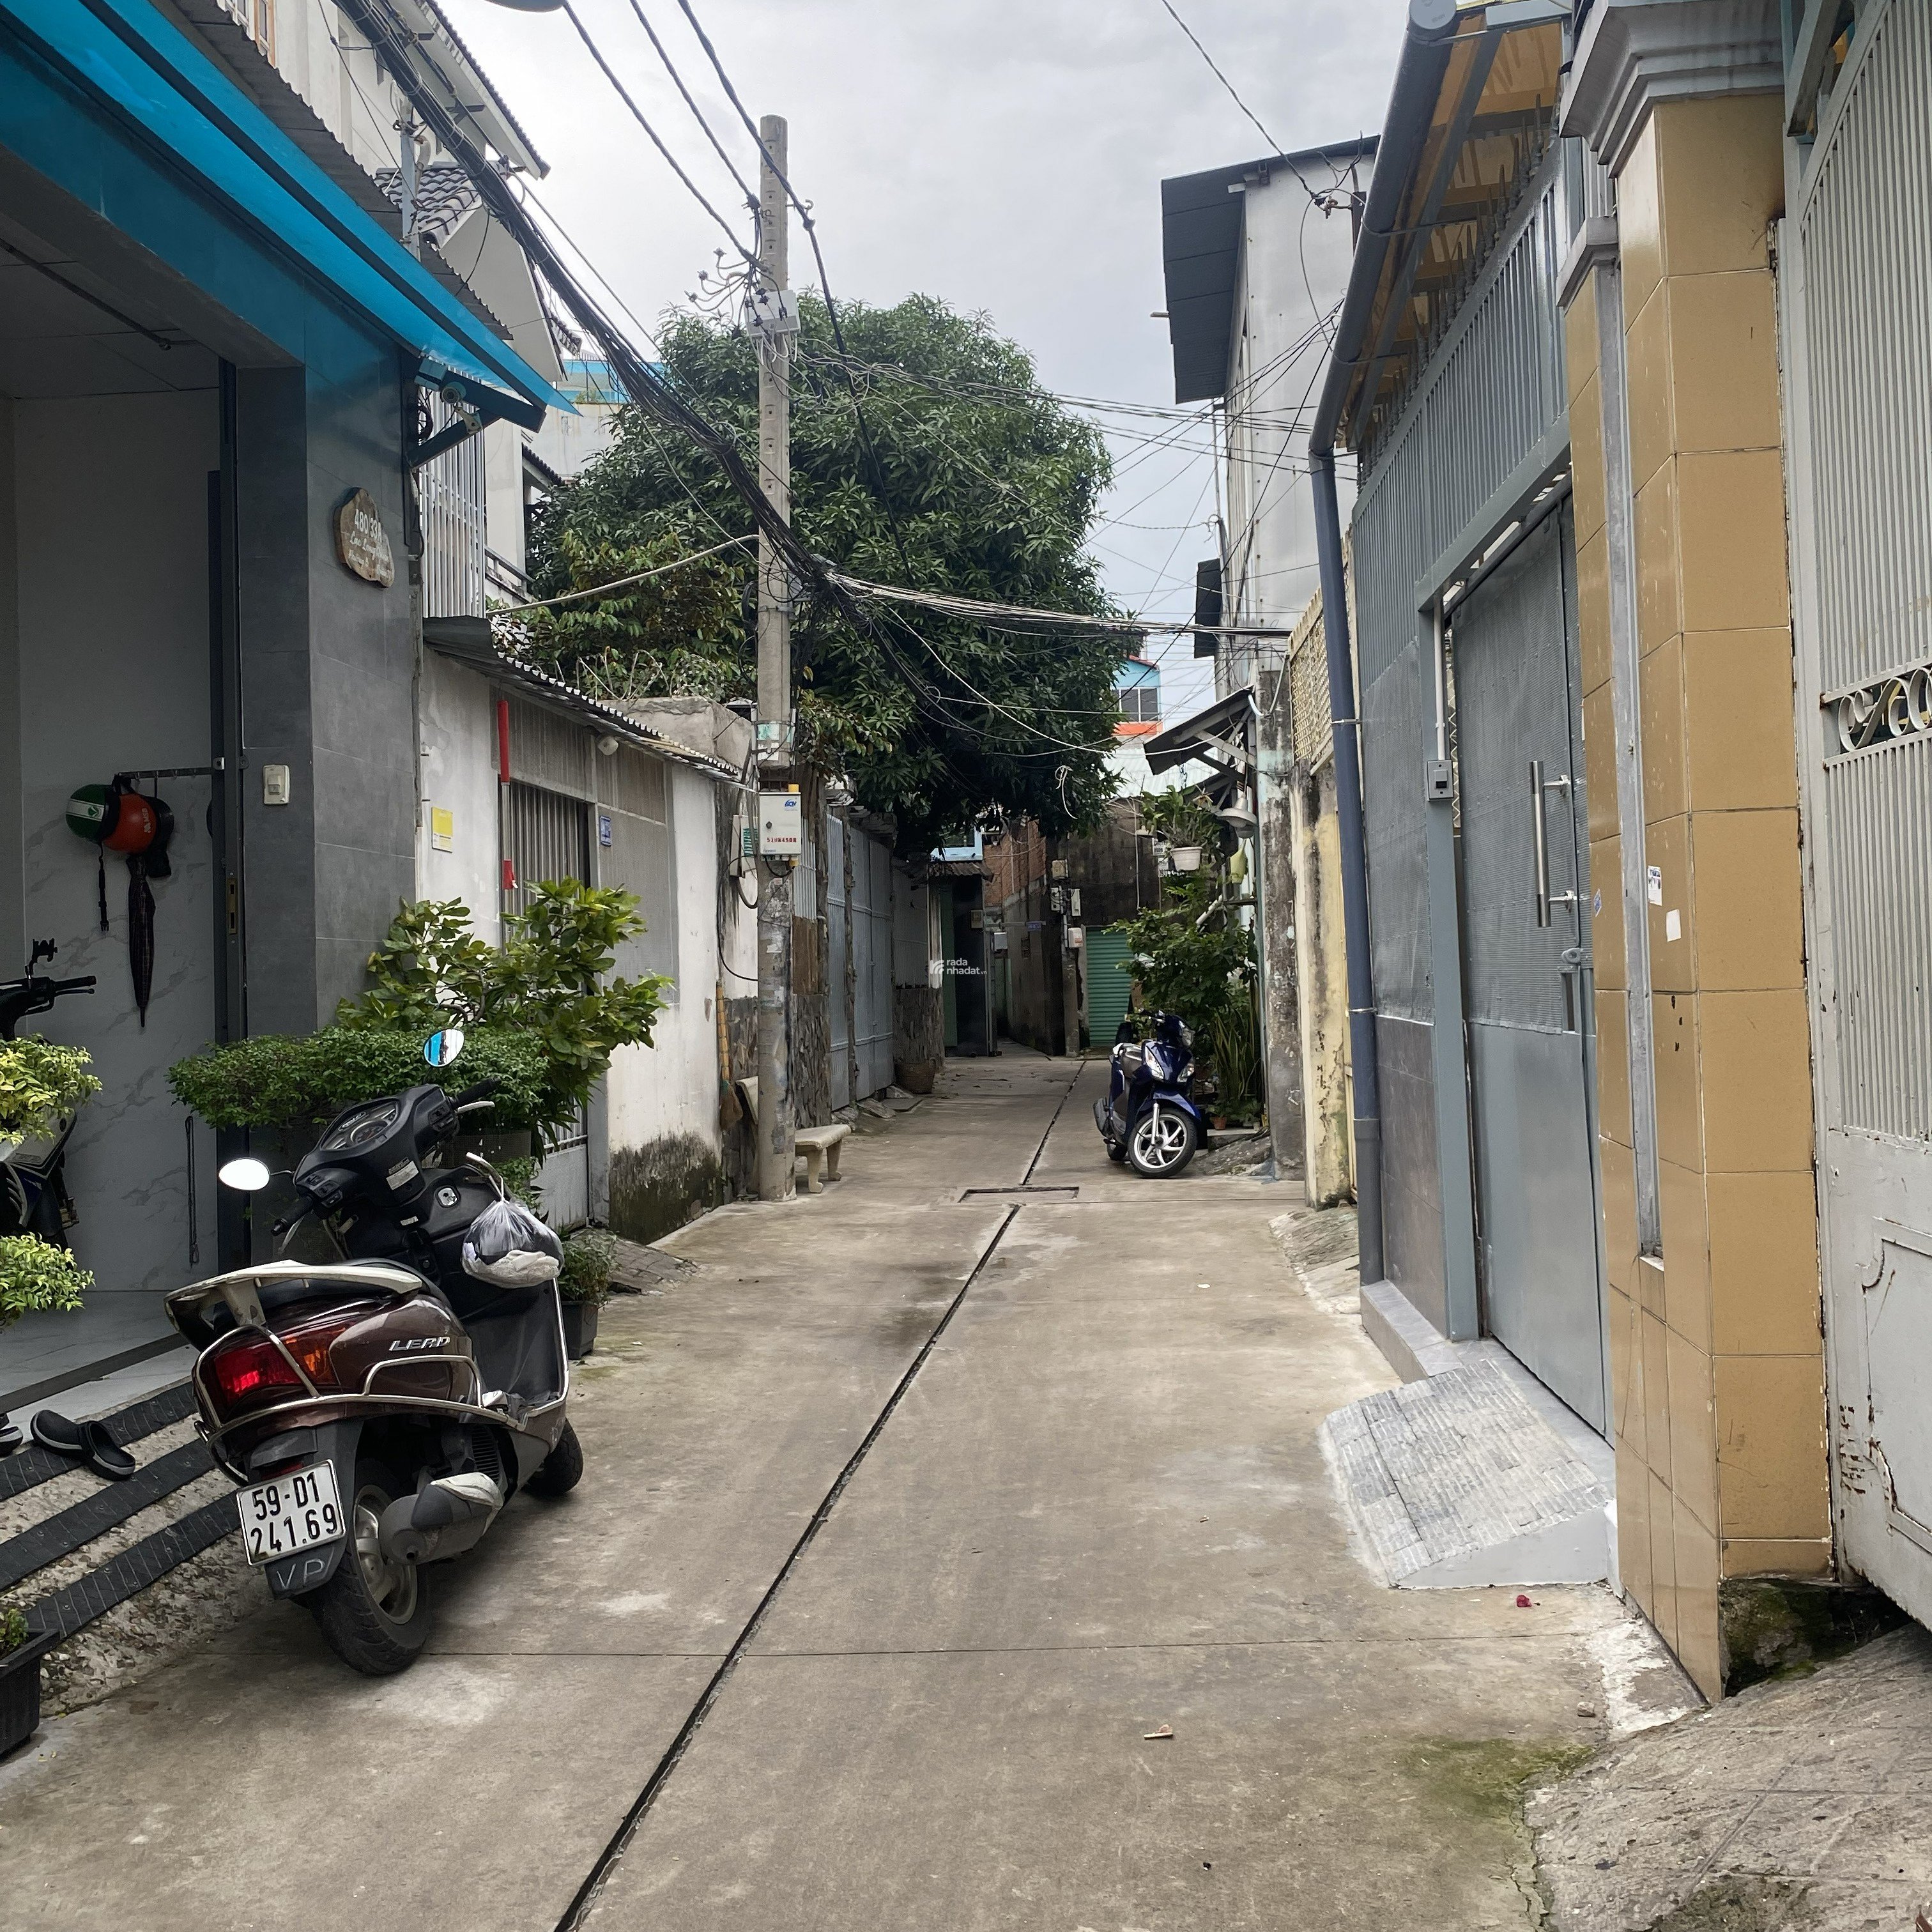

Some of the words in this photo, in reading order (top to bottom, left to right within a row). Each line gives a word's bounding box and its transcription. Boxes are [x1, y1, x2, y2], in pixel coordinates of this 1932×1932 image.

[354, 509, 383, 544] 480/33A
[388, 1336, 451, 1352] LEAD
[251, 1471, 320, 1521] 59-D1
[250, 1503, 338, 1560] 241.69
